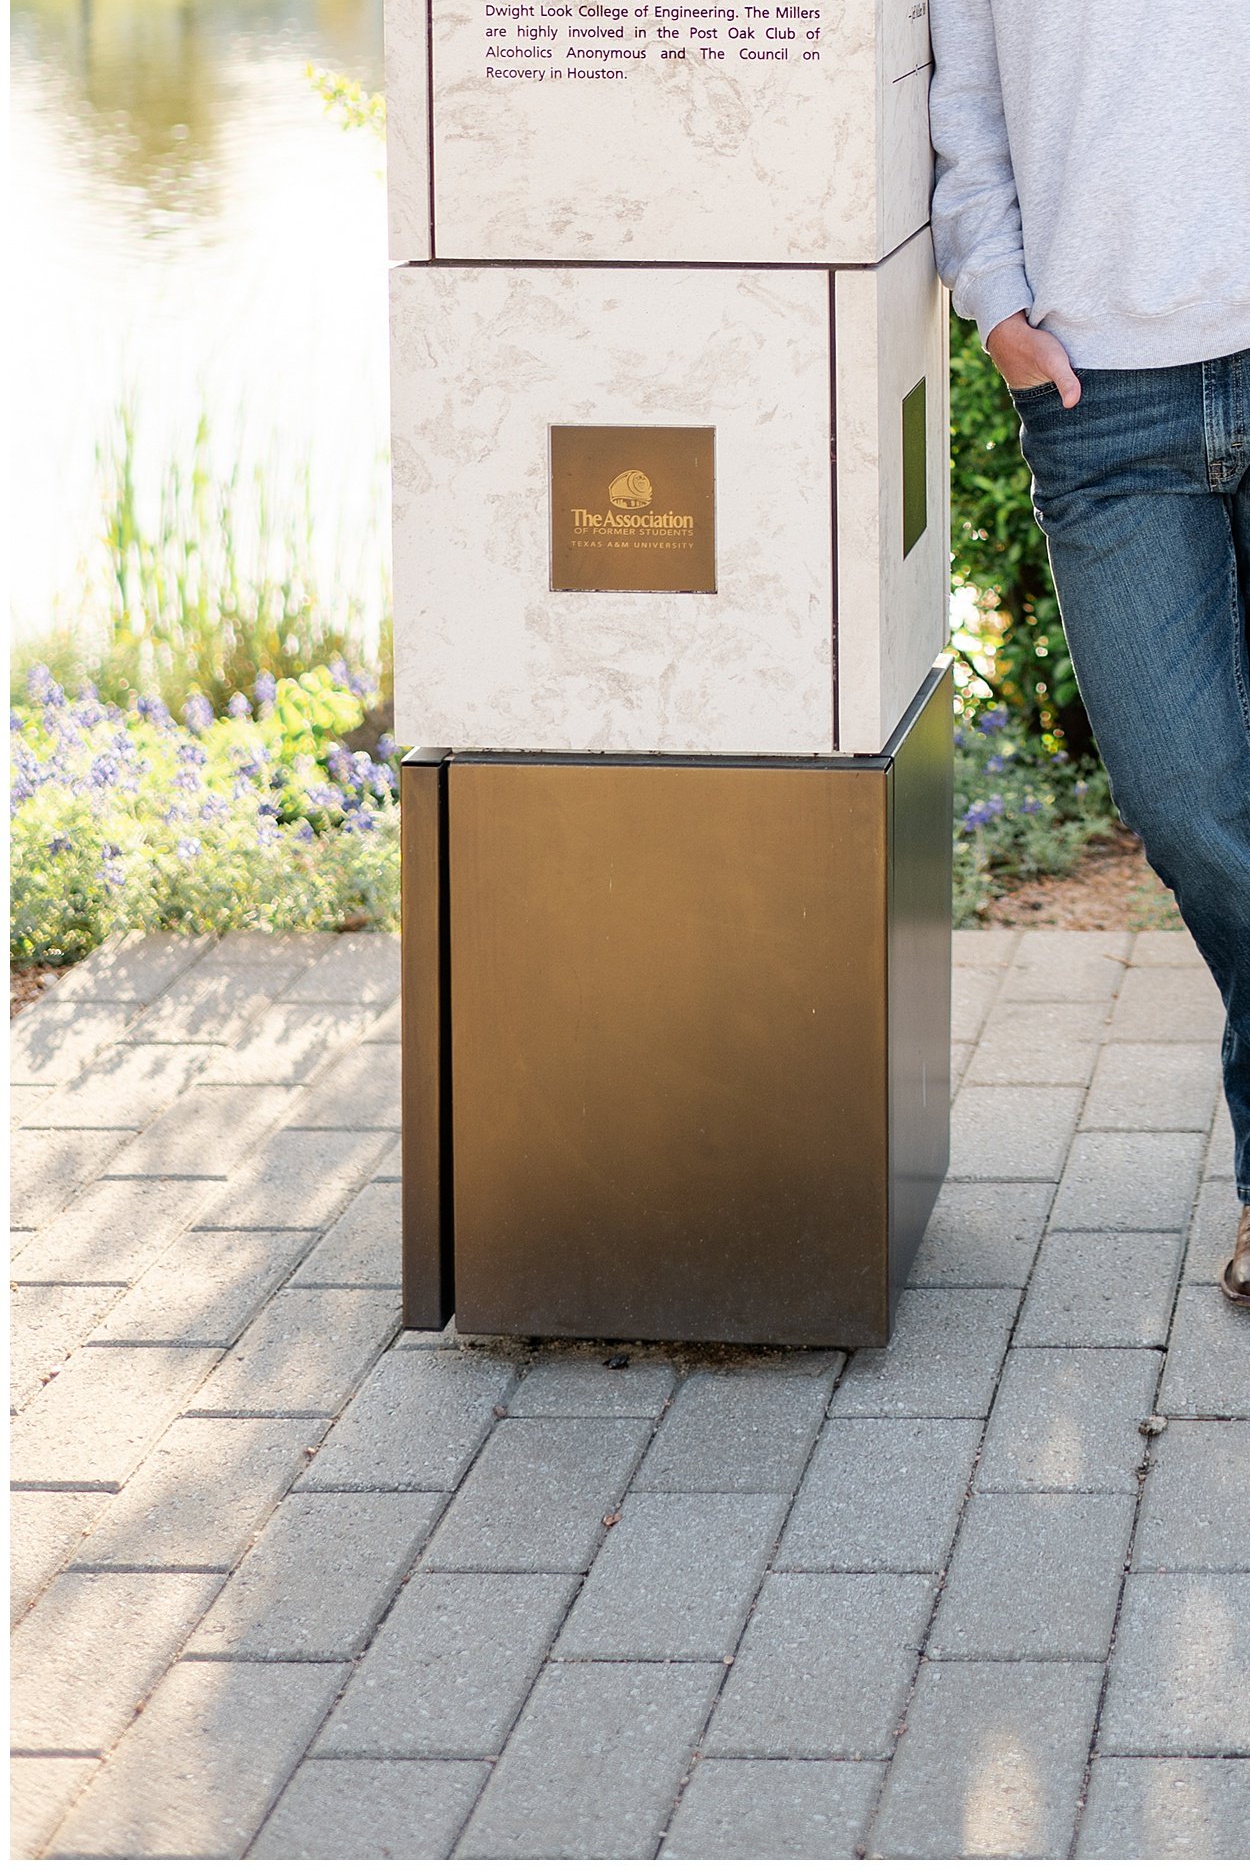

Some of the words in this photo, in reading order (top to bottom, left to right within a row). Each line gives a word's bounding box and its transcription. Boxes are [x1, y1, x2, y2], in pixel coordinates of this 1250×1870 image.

[485, 28, 507, 37] are
[517, 25, 558, 41] highly
[568, 26, 624, 38] involved
[634, 26, 646, 38] in
[656, 26, 680, 39] the
[690, 27, 718, 39] Post
[728, 26, 755, 39] Oak
[765, 27, 796, 40] Club
[806, 27, 821, 40] of
[485, 46, 552, 58] Alcoholics
[566, 47, 646, 62] Anonymous
[660, 47, 686, 60] and
[699, 47, 725, 60] The
[739, 48, 788, 60] Council
[802, 51, 820, 60] on
[486, 66, 546, 82] Recovery
[550, 66, 562, 79] in
[567, 67, 628, 80] Houston.
[571, 509, 602, 527] The
[603, 509, 694, 528] Association
[574, 527, 588, 535] OF
[593, 527, 636, 536] FORMER
[639, 528, 694, 537] STUDENTS
[571, 540, 602, 548] TEXAS
[634, 541, 694, 549] UNIVERSITY
